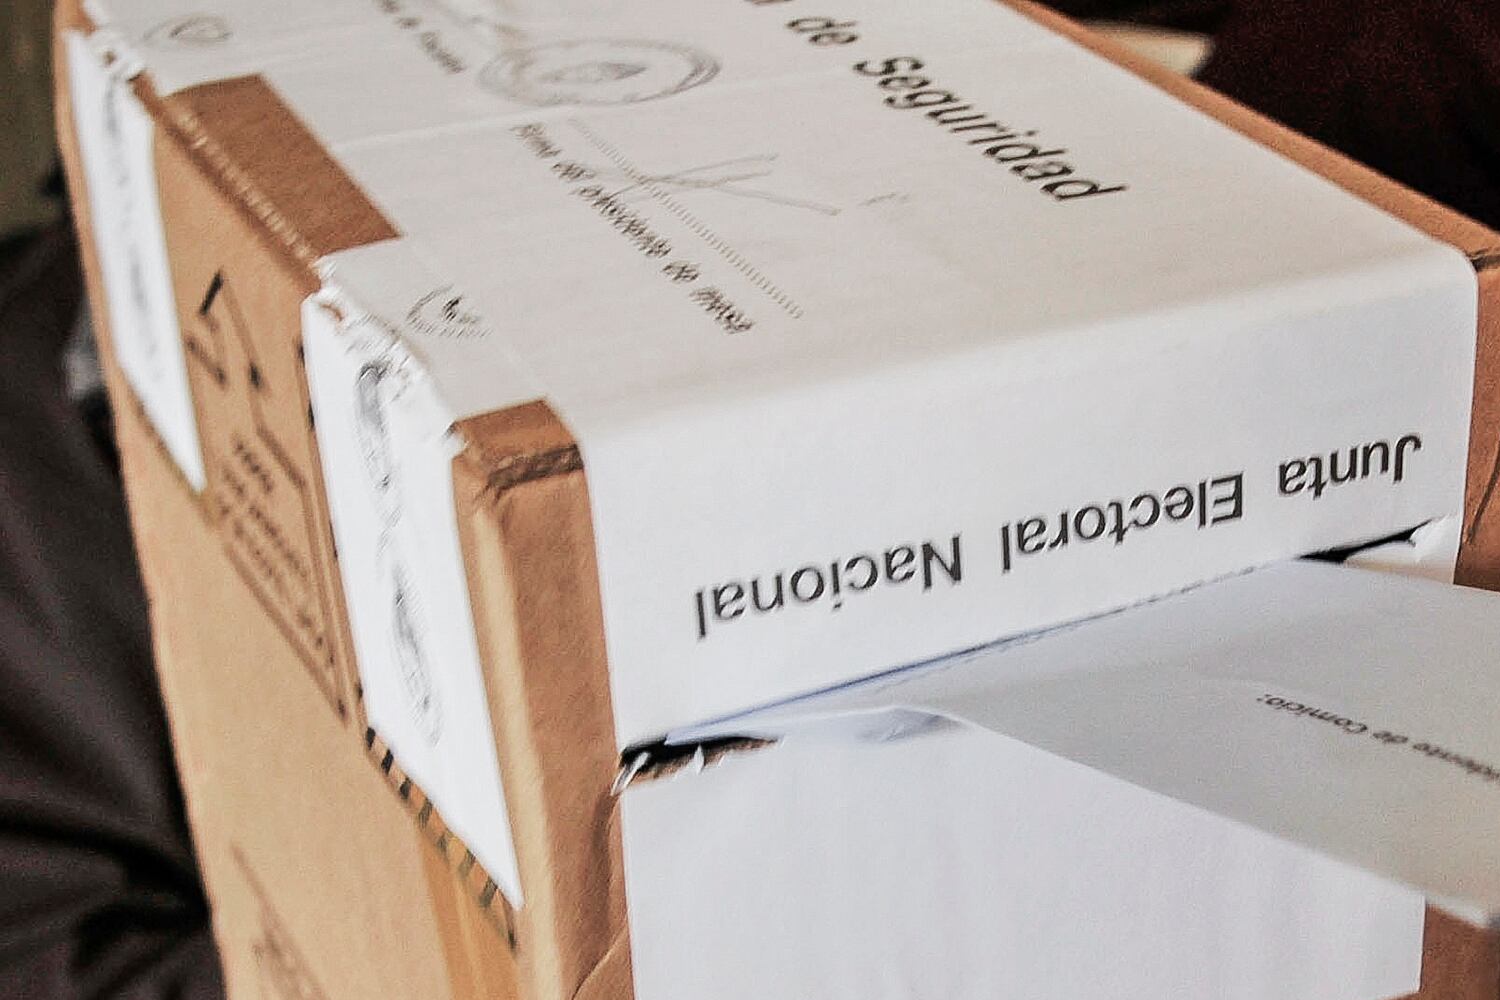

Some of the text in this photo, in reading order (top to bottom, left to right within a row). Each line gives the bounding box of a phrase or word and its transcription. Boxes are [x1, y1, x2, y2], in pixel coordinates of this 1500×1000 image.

[785, 16, 1128, 200] de Seguridad
[695, 434, 1422, 640] Junta Electoral Nacional
[1256, 693, 1368, 734] Comicio:
